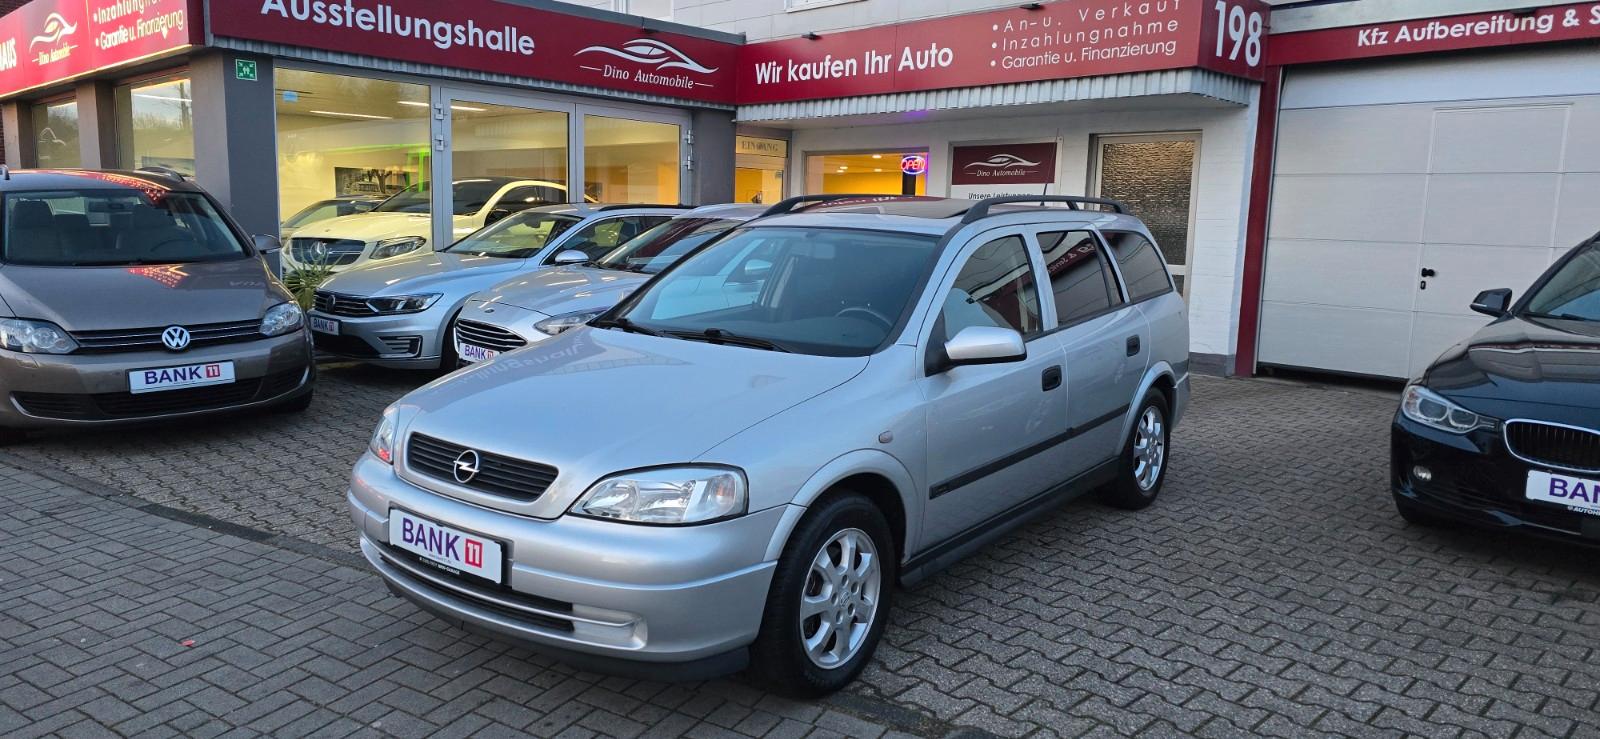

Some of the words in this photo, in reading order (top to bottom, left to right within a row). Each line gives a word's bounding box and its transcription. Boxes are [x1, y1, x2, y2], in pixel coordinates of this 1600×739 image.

[101, 25, 129, 50] Garantie
[136, 9, 184, 38] Finanzierung
[260, 0, 536, 56] Ausstellungshalle
[1003, 20, 1178, 51] Inzahlungnahme
[1214, 0, 1263, 68] 198
[1357, 28, 1389, 48] Kfz
[1394, 12, 1555, 44] Aufbereitung
[1562, 9, 1581, 28] &
[755, 61, 784, 85] Wir
[787, 54, 858, 82] kaufen
[864, 49, 892, 75] Ihr
[897, 42, 954, 72] Auto
[1002, 51, 1060, 69] Garantie
[1064, 52, 1077, 63] u.
[1081, 39, 1177, 62] Finanzierung
[603, 64, 630, 80] Dino
[634, 69, 695, 89] Automobile
[901, 159, 926, 170] OPEN
[976, 169, 991, 177] Dino
[991, 168, 1026, 177] Automobile
[464, 344, 486, 360] BANK
[144, 365, 203, 385] BANK
[402, 517, 461, 562] BANK
[466, 541, 482, 566] 11
